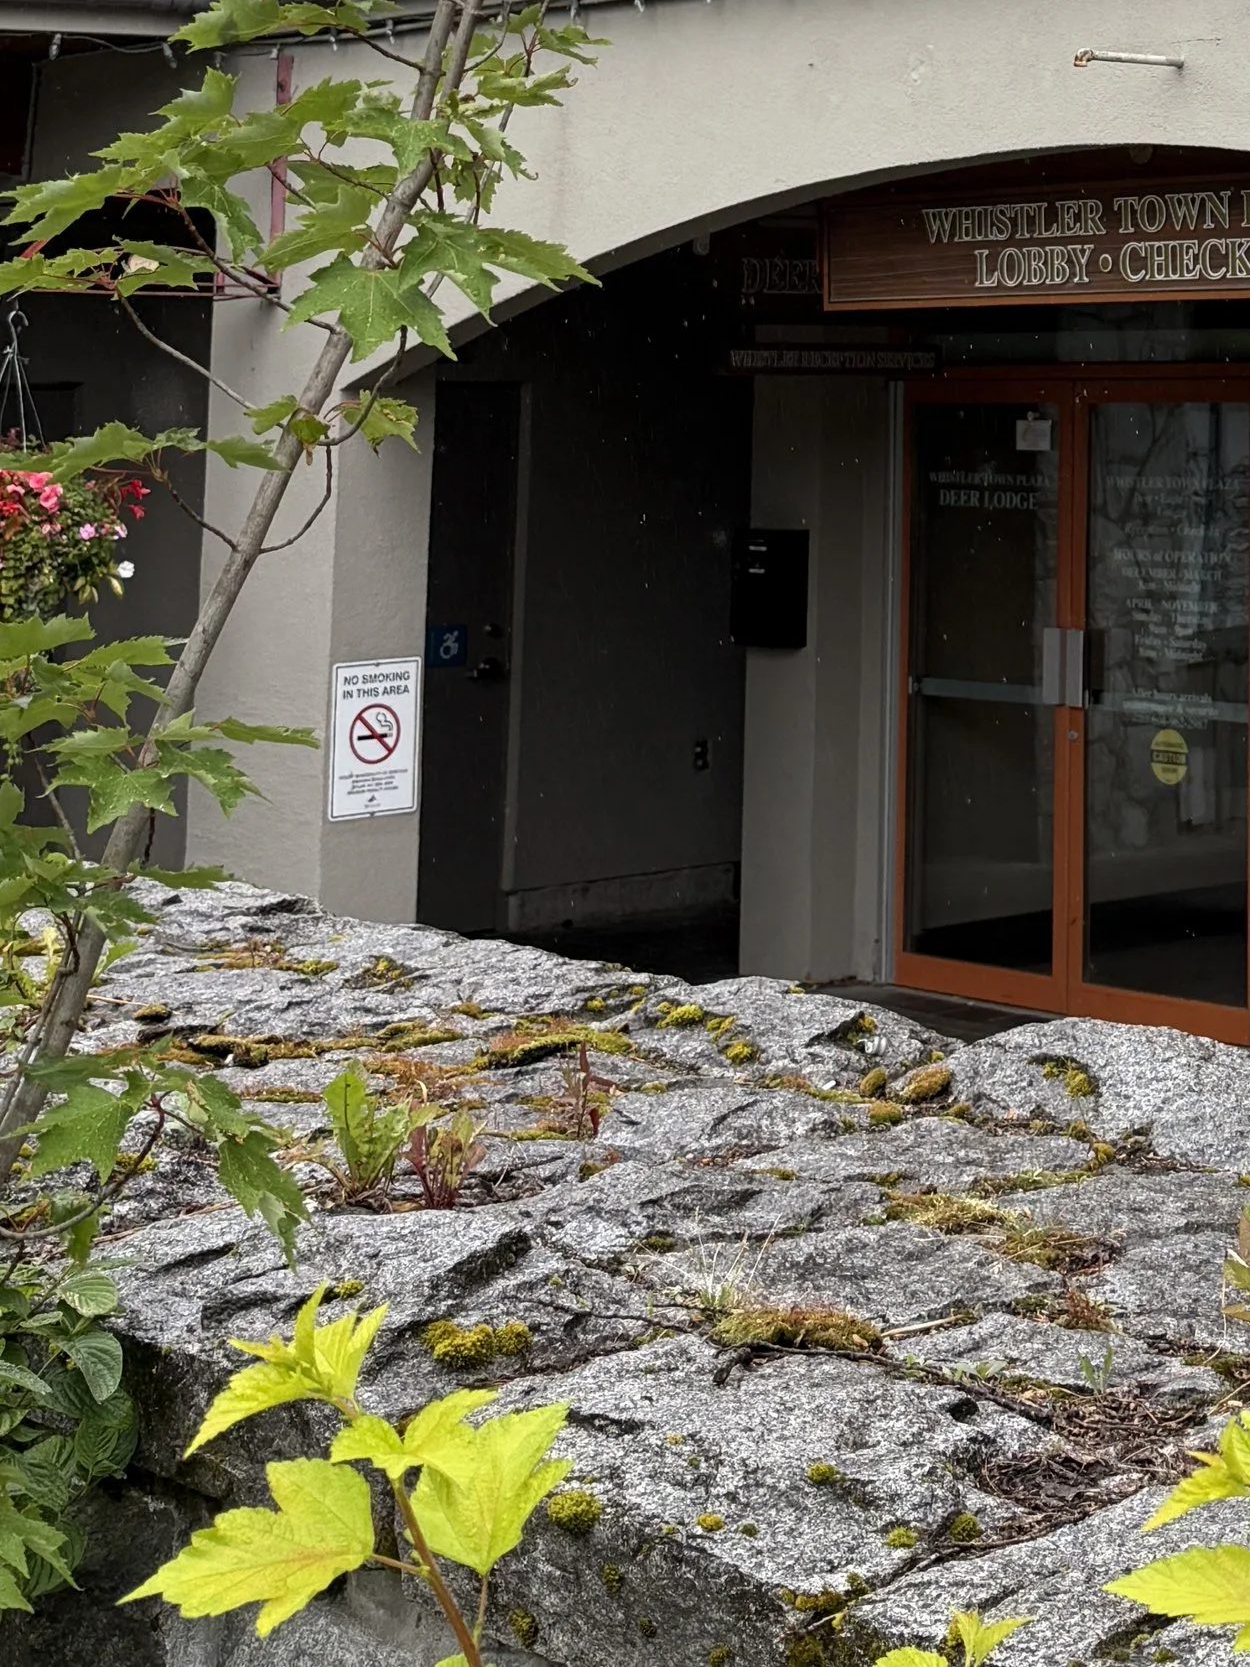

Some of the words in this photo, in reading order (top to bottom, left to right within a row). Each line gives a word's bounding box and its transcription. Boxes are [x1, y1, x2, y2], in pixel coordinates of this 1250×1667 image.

[922, 199, 1106, 243] WHISTLER
[1114, 191, 1229, 234] TOWN
[741, 257, 822, 294] DEER
[975, 244, 1094, 287] LOBBY
[939, 489, 980, 507] DEER
[984, 491, 1038, 510] LODGE
[343, 675, 359, 686] NO
[362, 671, 410, 684] SMOKING
[343, 689, 354, 700] IN
[356, 687, 380, 698] THIS
[382, 684, 410, 696] AREA
